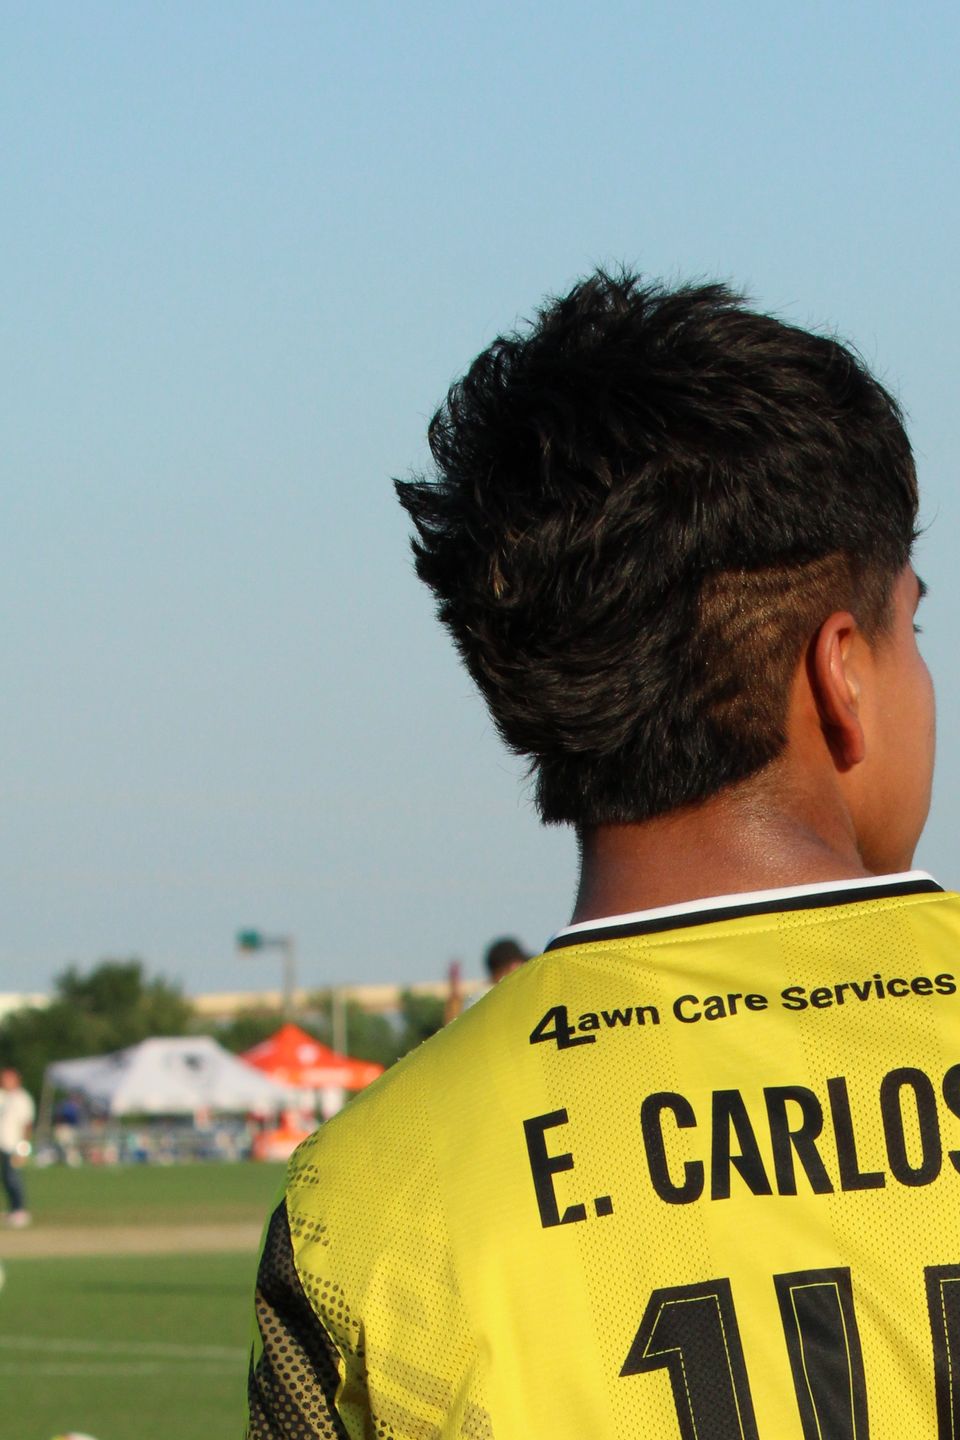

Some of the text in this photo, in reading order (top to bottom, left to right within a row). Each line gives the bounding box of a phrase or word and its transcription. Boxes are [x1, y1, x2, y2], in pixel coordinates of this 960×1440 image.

[672, 994, 769, 1024] Care
[780, 973, 957, 1012] Services
[522, 1108, 614, 1229] E.
